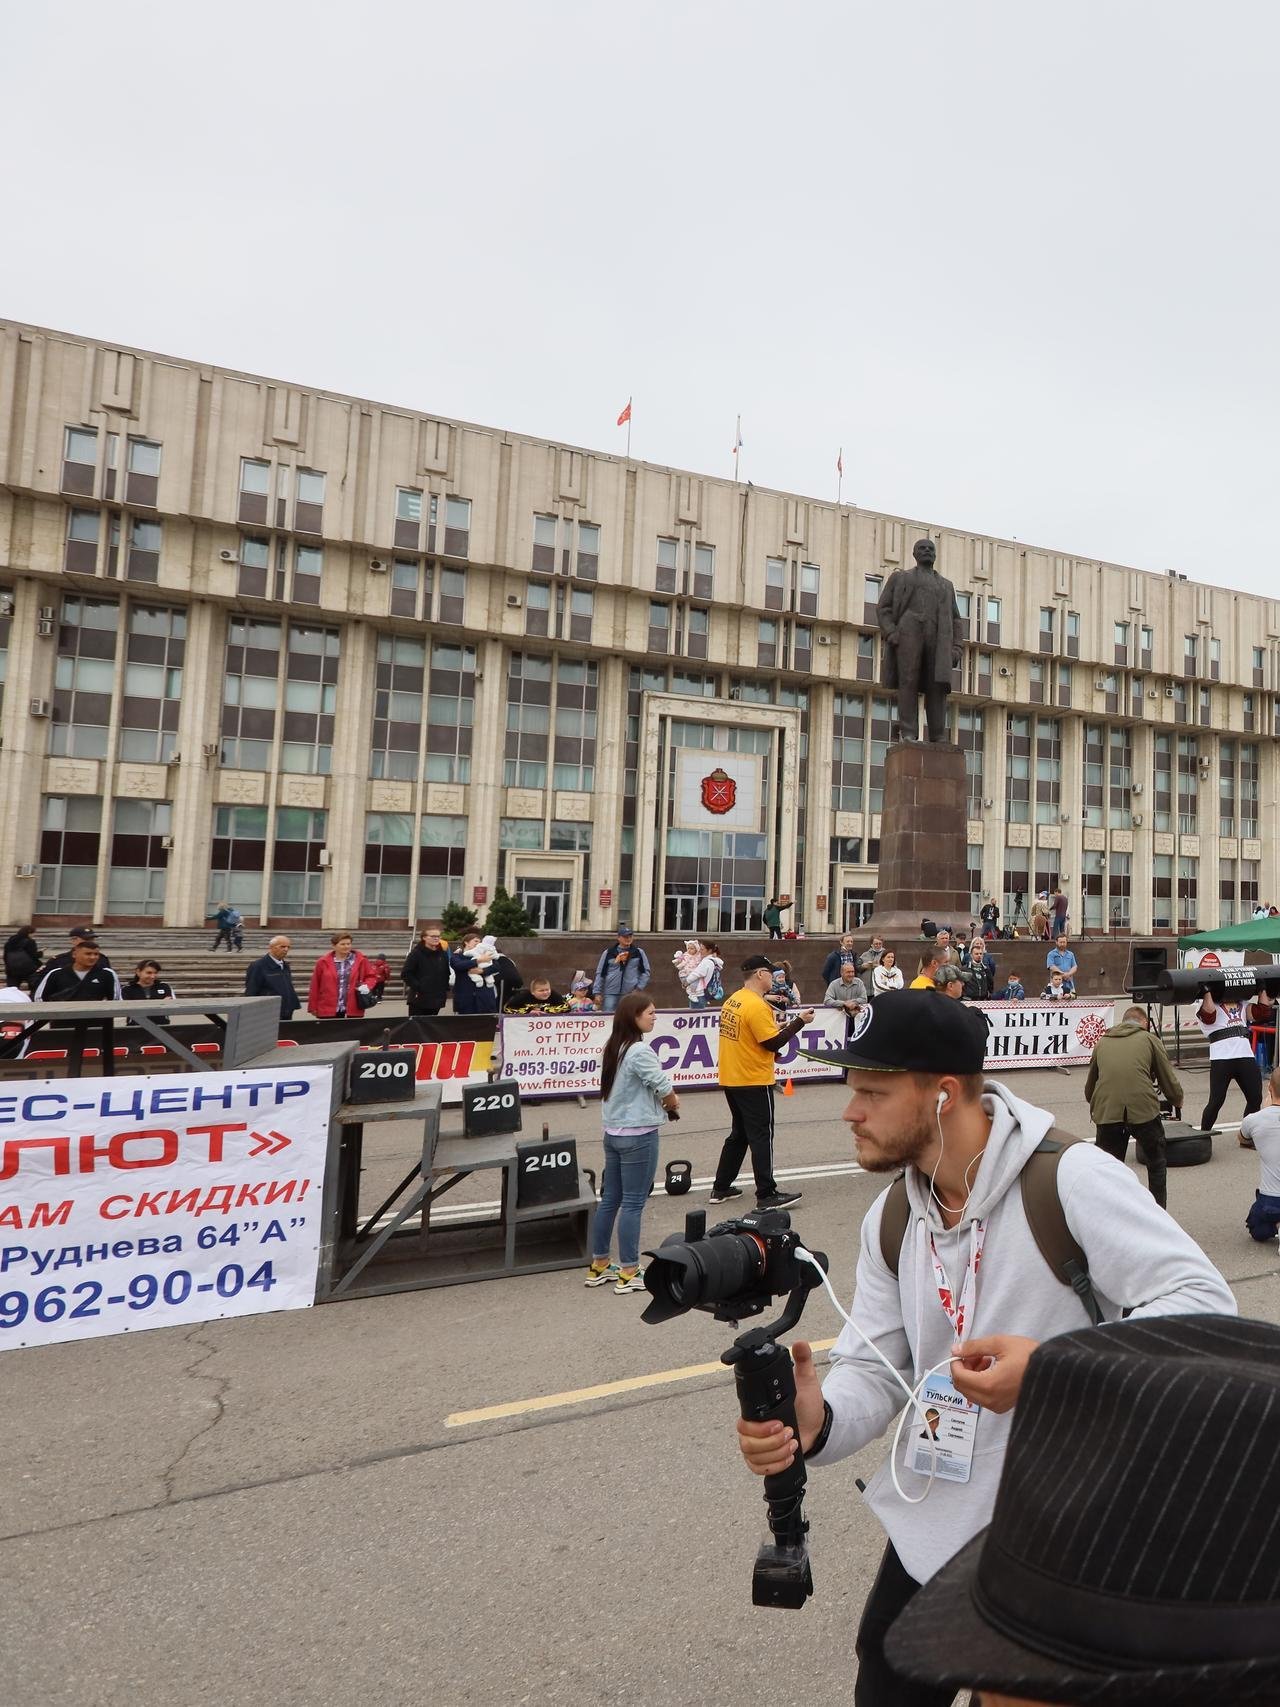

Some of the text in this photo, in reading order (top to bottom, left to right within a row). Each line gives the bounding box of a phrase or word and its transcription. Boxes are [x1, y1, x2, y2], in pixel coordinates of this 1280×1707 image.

[528, 1018, 606, 1033] 300 метров
[1005, 1012, 1069, 1028] БЫТЬ
[535, 1031, 590, 1045] от ТГПУ
[986, 1034, 1068, 1057] НЫМ
[513, 1048, 534, 1058] им.
[536, 1046, 560, 1056] Л.Н.
[359, 1061, 409, 1079] 200
[505, 1060, 601, 1077] 8-953-962-90-
[673, 1072, 719, 1082] Николая
[472, 1093, 515, 1112] 220
[524, 1151, 571, 1173] 240
[671, 1174, 683, 1184] 24
[99, 1179, 311, 1221] СКИДКИ!
[1, 1234, 184, 1276] Руднева
[0, 1260, 278, 1329] 962-90-04
